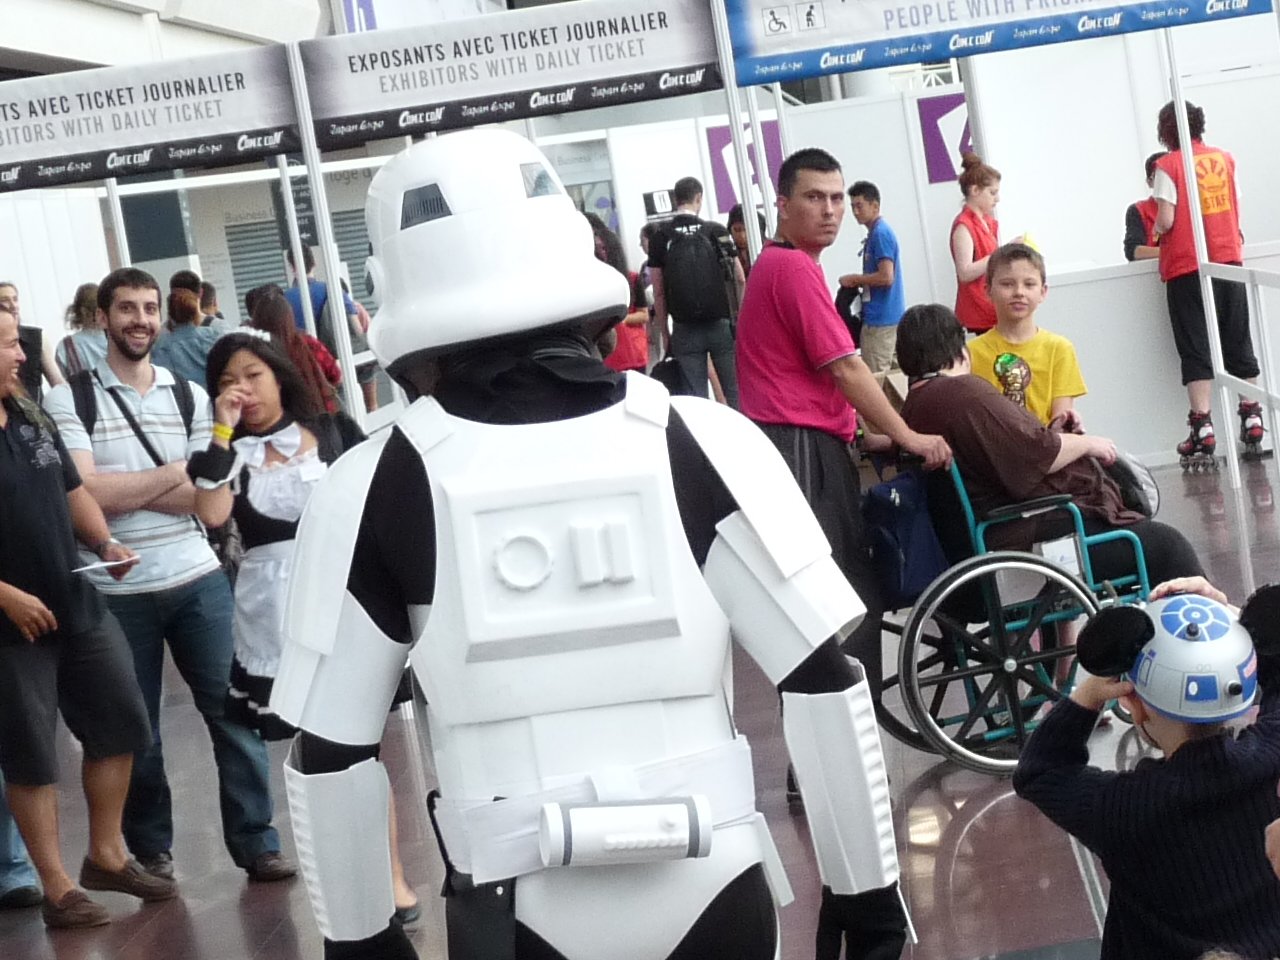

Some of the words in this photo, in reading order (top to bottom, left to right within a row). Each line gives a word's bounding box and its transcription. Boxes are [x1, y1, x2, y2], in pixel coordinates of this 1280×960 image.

[884, 1, 959, 30] PEOPLE
[966, 0, 1015, 18] WITH
[348, 43, 446, 73] EXPOSANTS
[453, 36, 494, 59] AVEC
[501, 27, 560, 51] TICKET
[566, 11, 668, 42] JOURNALIER
[379, 63, 479, 93] EXHIBITORS
[486, 55, 528, 78] WITH
[535, 46, 581, 70] DAILY
[587, 38, 646, 63] TICKET
[29, 96, 70, 118] AVEC
[76, 86, 135, 111] TICKET
[142, 72, 247, 104] JOURNALIER
[62, 118, 104, 138] WITH
[113, 107, 158, 131] DAILY
[164, 100, 223, 124] TICKET
[1203, 194, 1229, 208] STAF
